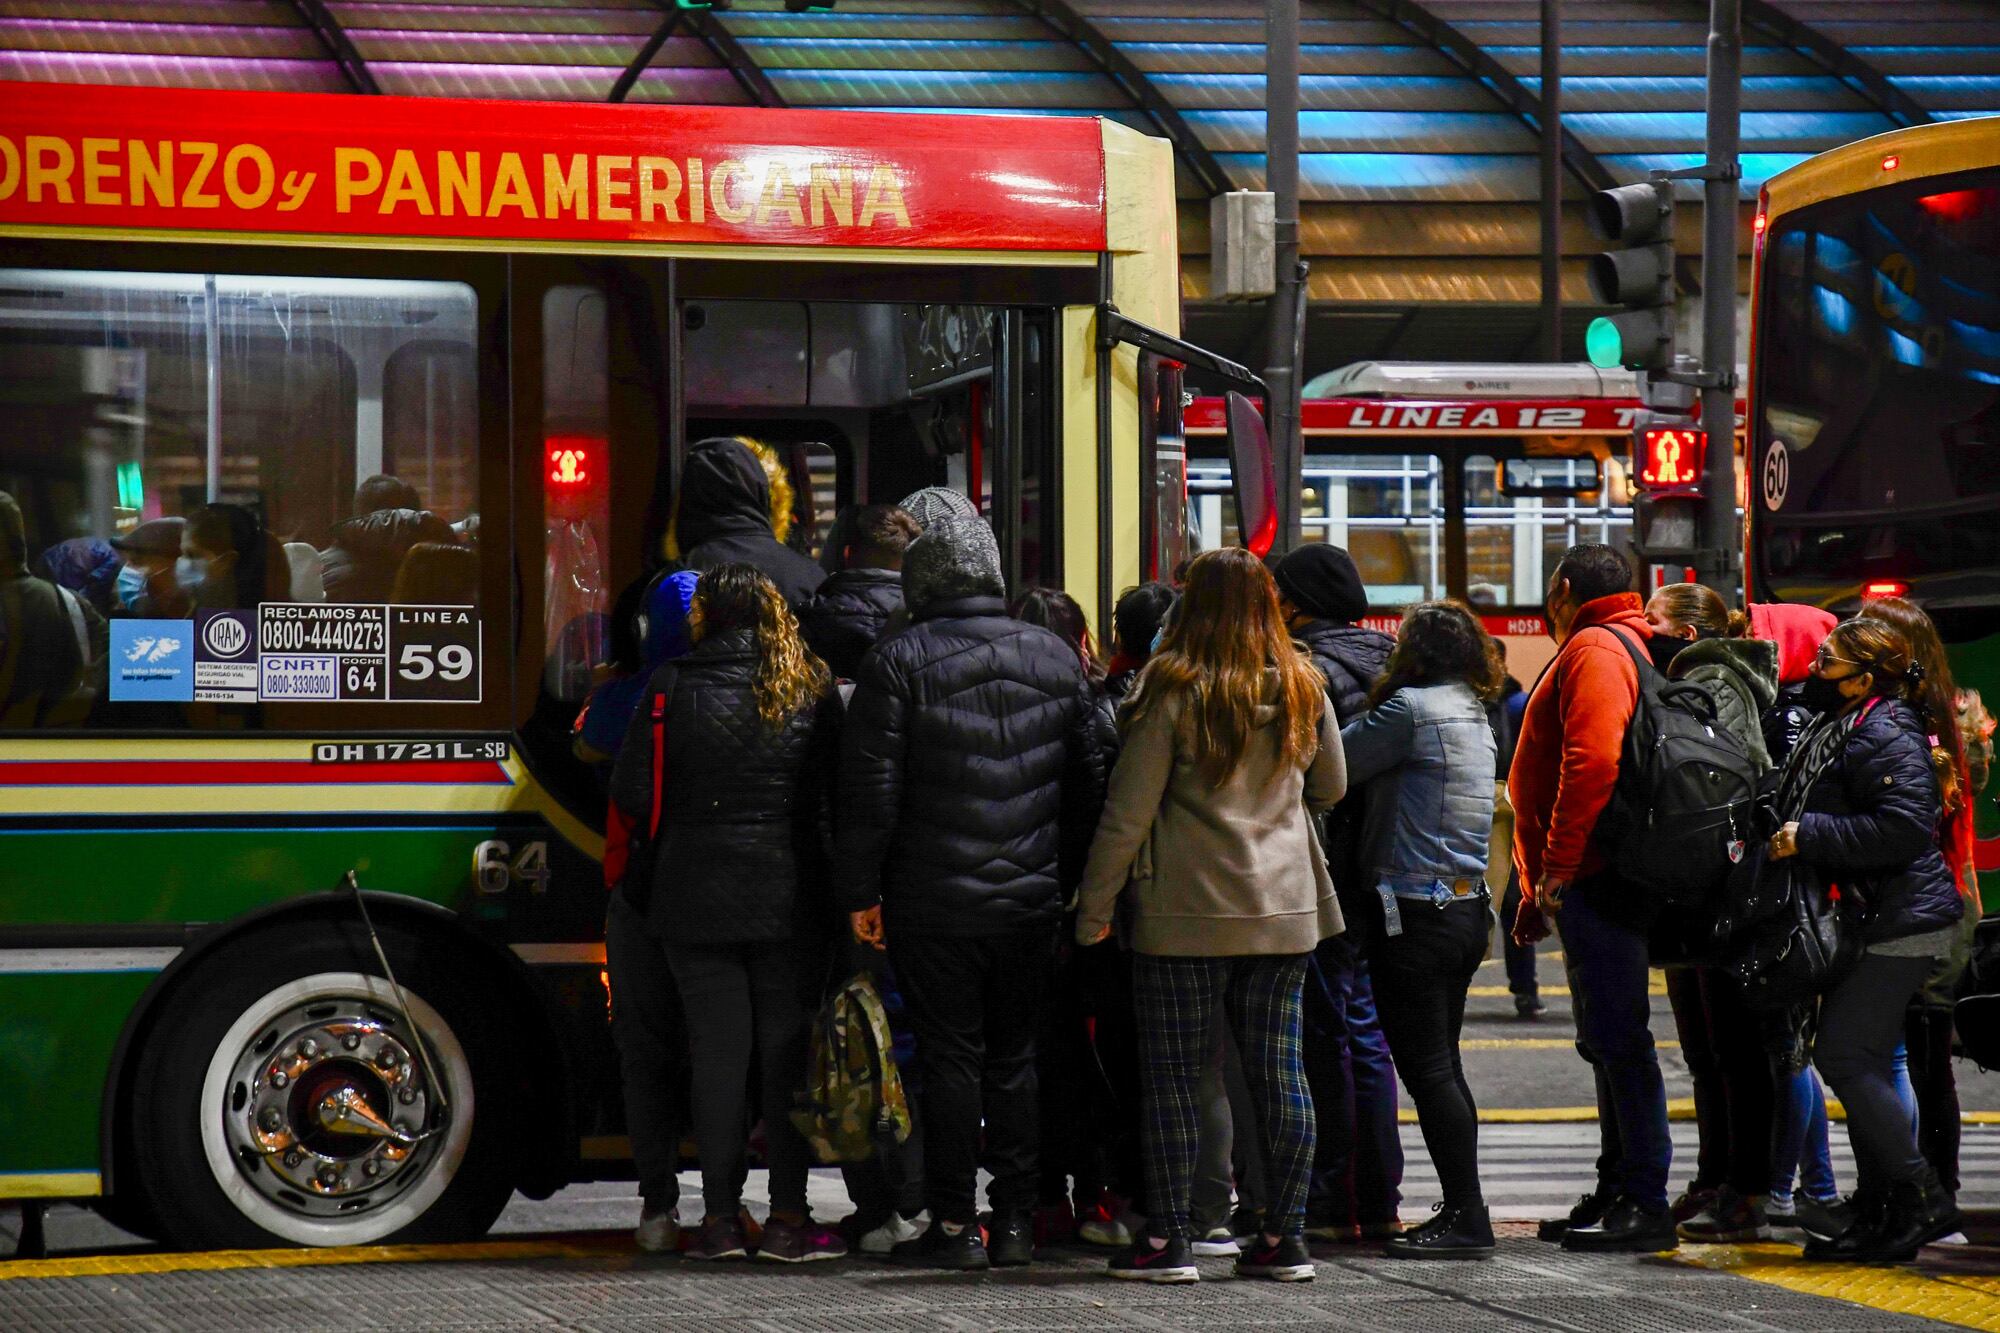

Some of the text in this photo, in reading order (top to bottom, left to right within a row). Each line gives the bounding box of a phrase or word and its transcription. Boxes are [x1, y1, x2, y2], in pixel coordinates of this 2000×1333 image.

[276, 170, 317, 212] y
[335, 147, 913, 229] PANAMERICANA
[1349, 407, 1586, 427] LINEA 12
[1766, 450, 1786, 499] 60
[264, 608, 381, 620] RECLAMOS AL
[400, 612, 469, 624] LINEA
[213, 621, 241, 649] IRAM
[263, 620, 384, 650] 0800-4440273
[1361, 618, 1402, 634] PALER
[267, 659, 331, 671] CNRT
[398, 644, 473, 681] 59
[267, 675, 330, 693] 0800-3330300
[346, 666, 377, 692] 64
[317, 744, 364, 761] OH
[474, 840, 550, 894] 64
